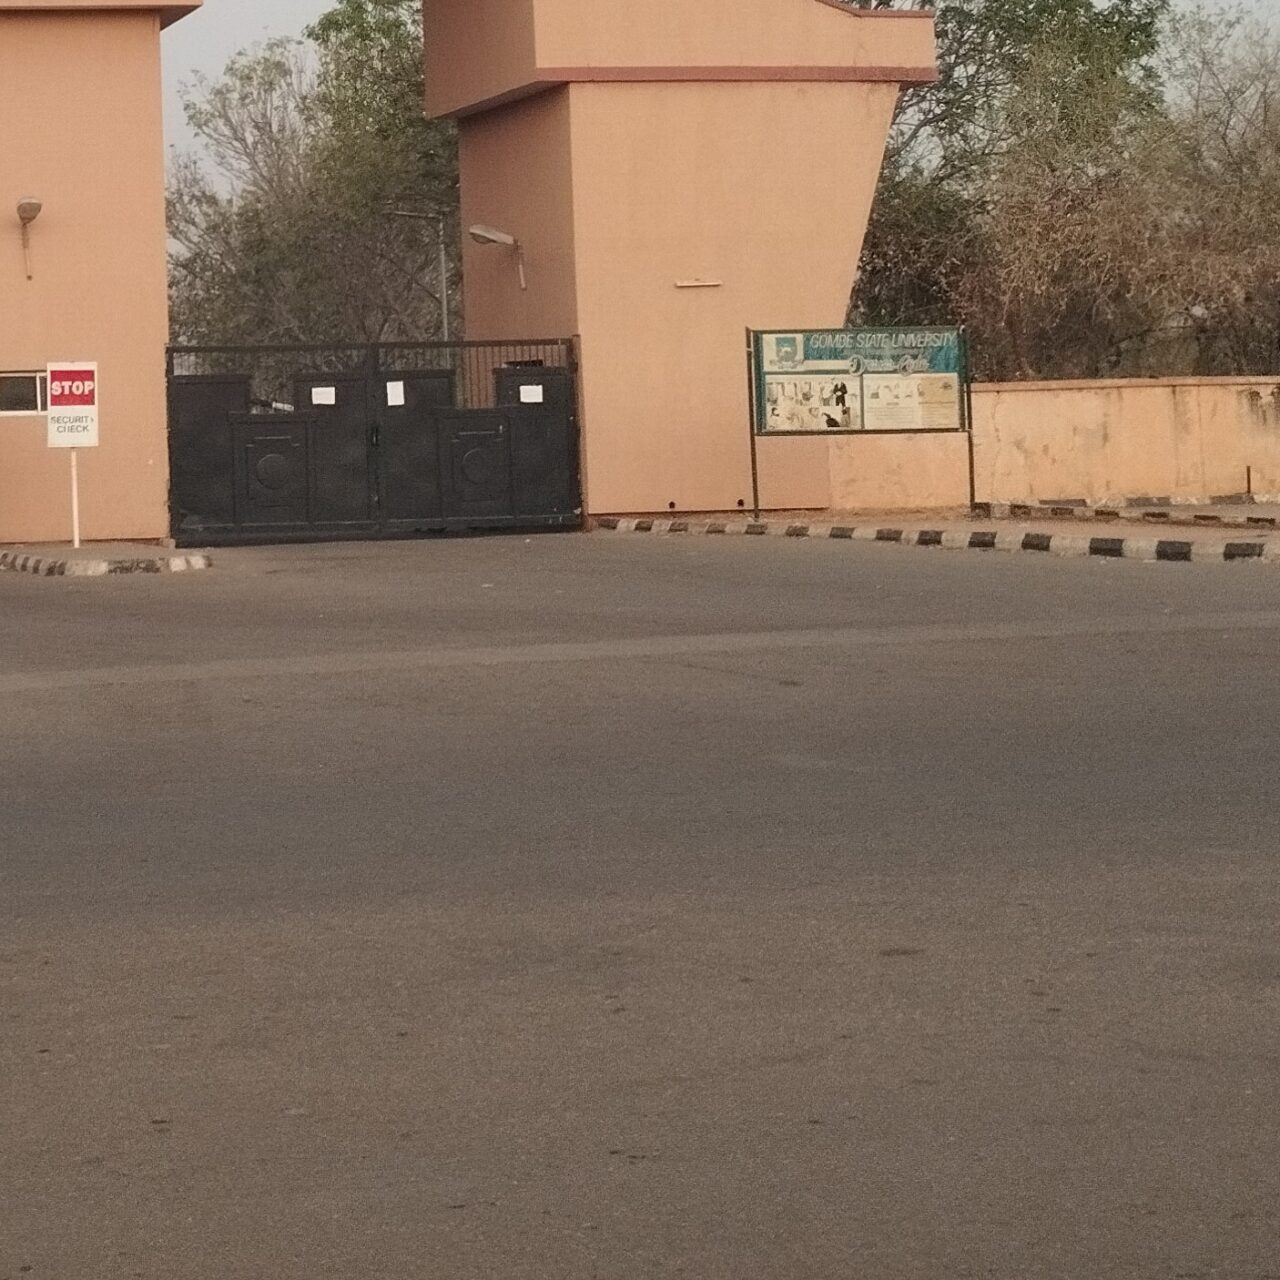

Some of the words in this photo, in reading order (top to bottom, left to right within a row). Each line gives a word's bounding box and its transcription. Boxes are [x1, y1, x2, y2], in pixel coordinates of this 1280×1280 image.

[809, 333, 855, 349] GOMBE
[855, 333, 891, 348] STATE
[891, 331, 958, 348] UNIVERSITY
[51, 380, 94, 396] STOP
[56, 424, 90, 434] CHECK
